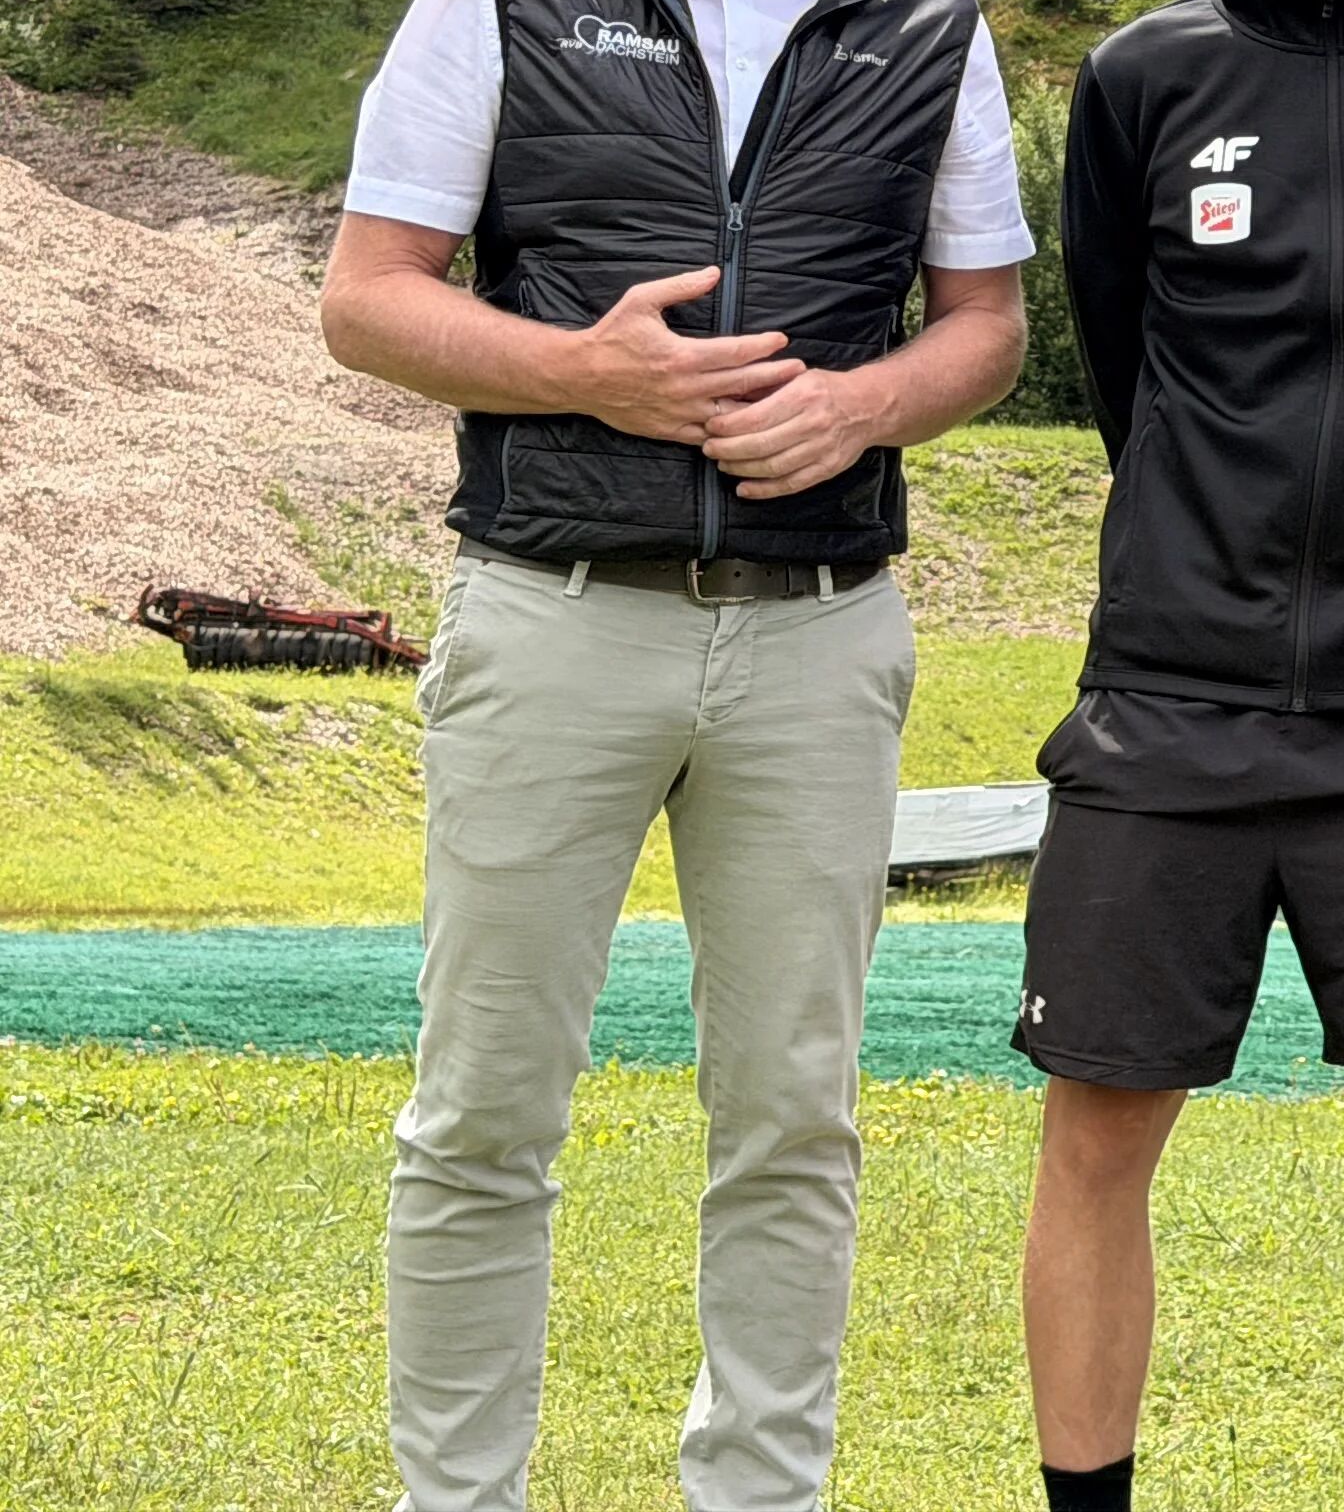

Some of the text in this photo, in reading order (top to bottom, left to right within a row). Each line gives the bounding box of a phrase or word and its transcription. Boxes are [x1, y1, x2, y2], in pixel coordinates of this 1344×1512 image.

[595, 41, 680, 66] DACHSTEIN
[598, 28, 680, 54] RAMSAU
[1190, 136, 1260, 172] 4F
[1200, 197, 1241, 226] Stiegl
